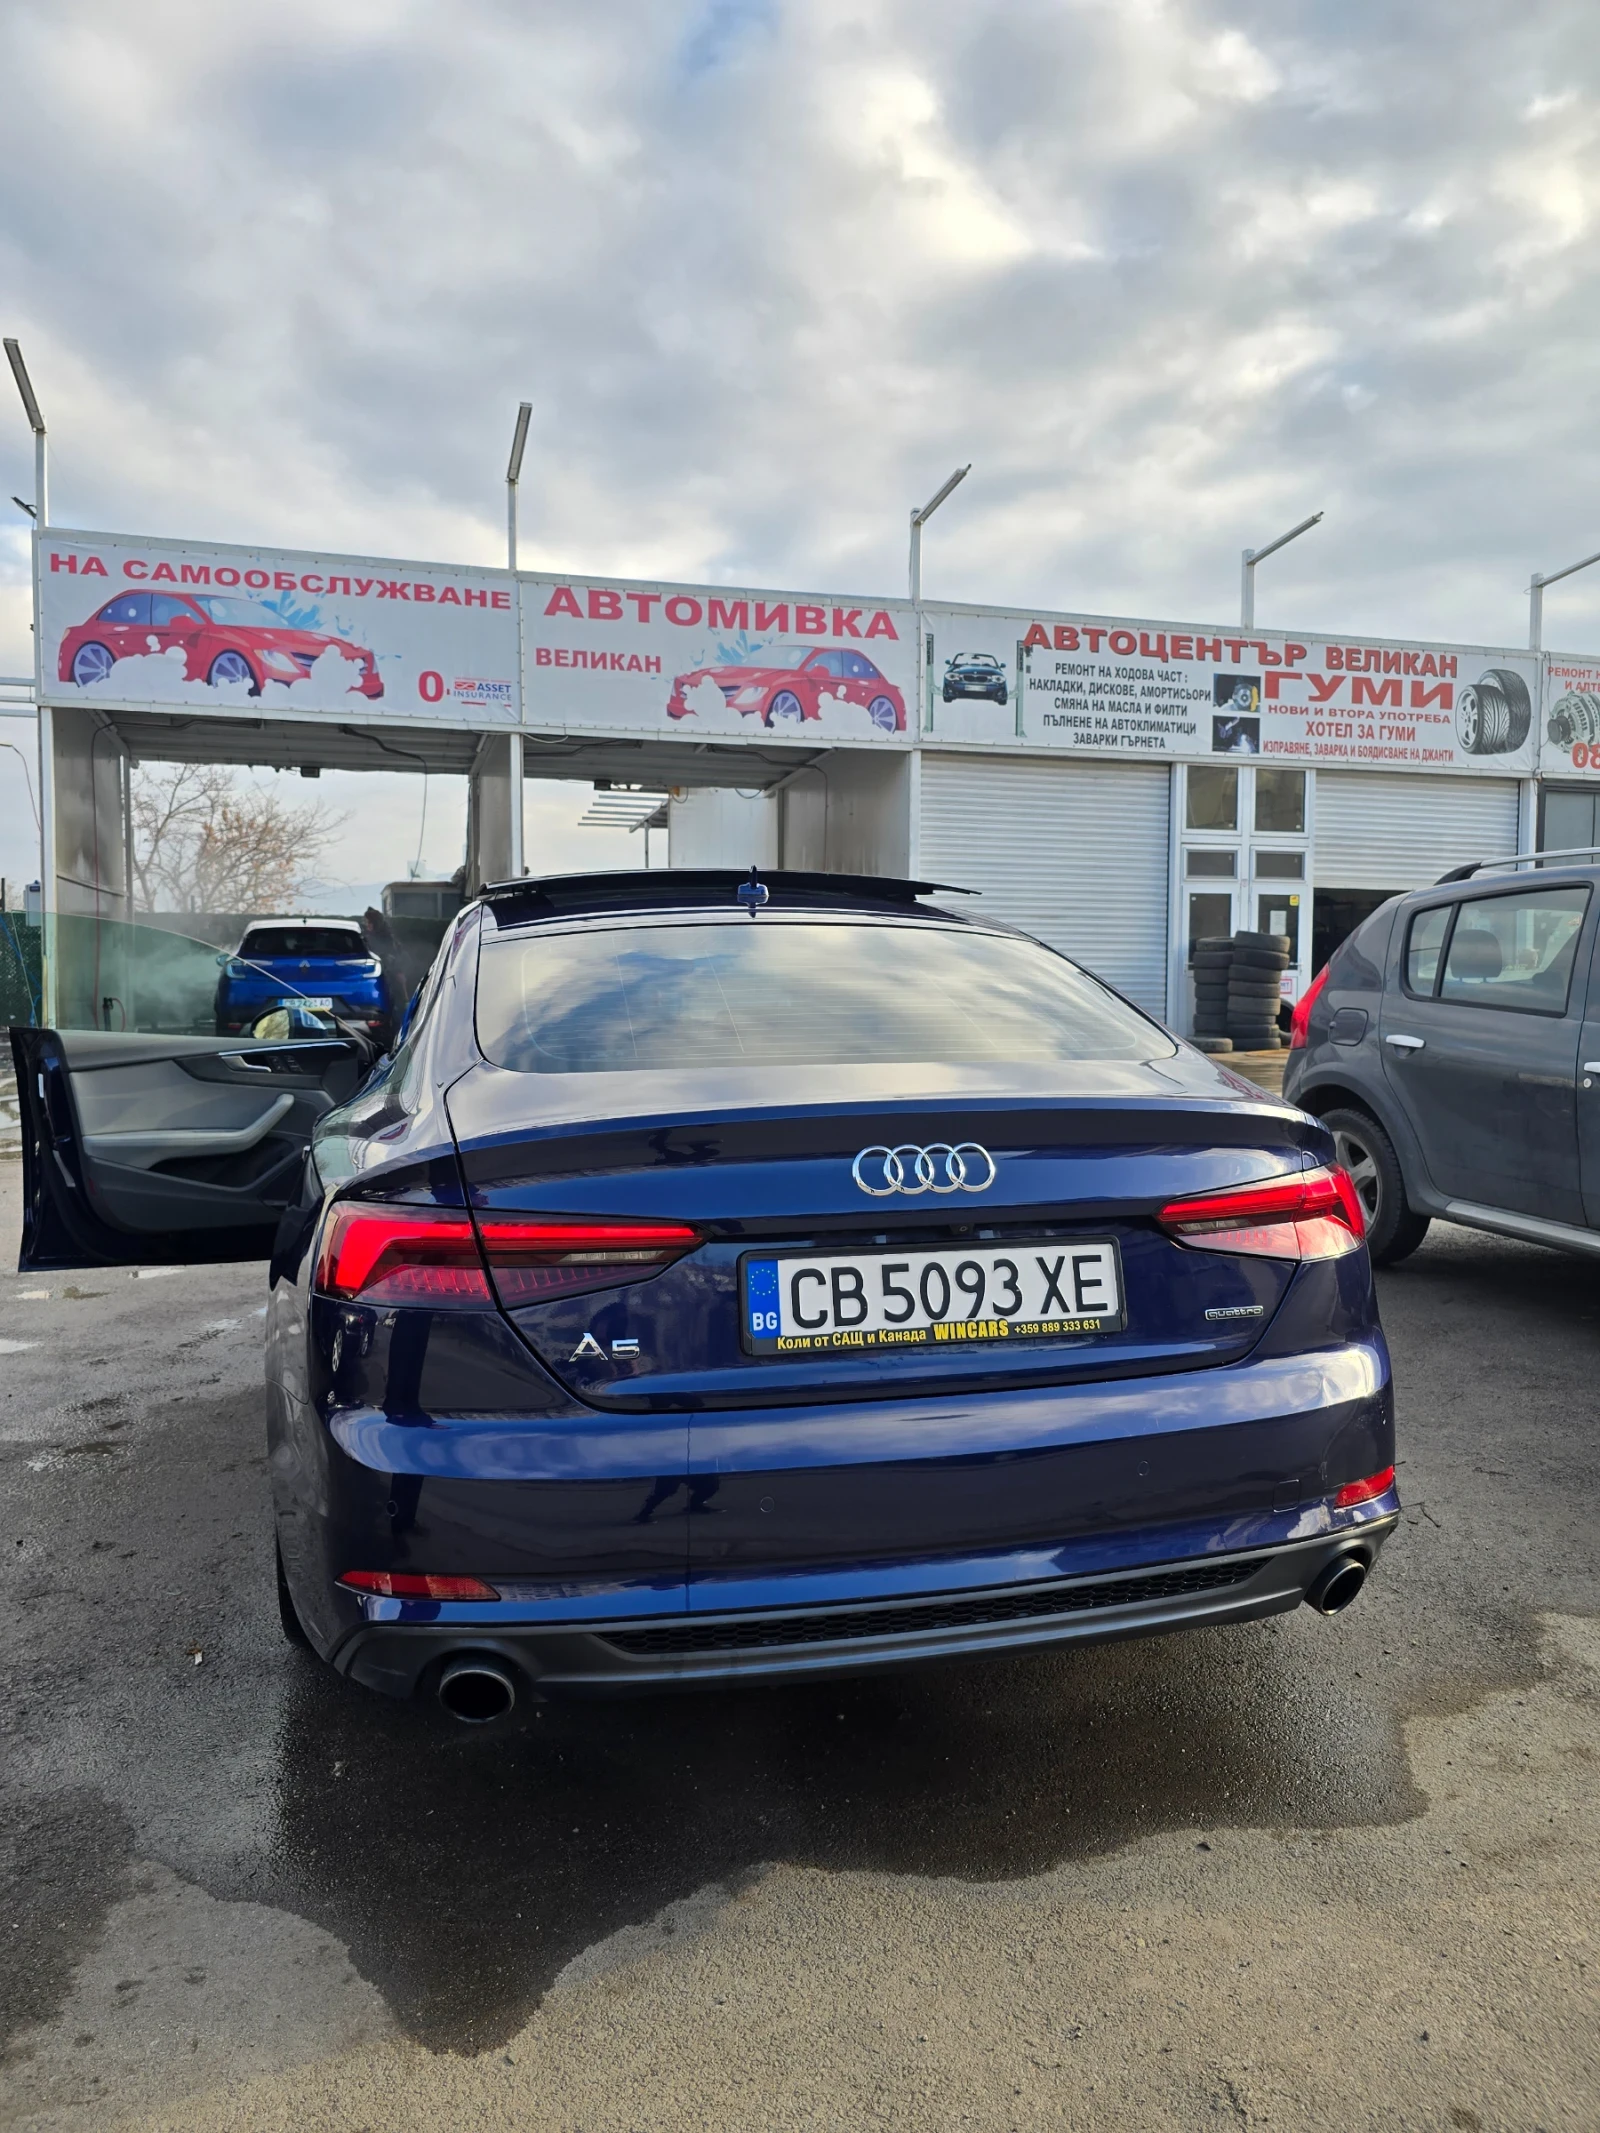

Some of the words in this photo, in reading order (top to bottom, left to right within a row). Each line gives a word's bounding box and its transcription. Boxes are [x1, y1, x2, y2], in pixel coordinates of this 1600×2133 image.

[50, 553, 108, 577] НА
[122, 559, 511, 610] САМООБСЛУЖВАНЕ
[544, 587, 899, 640] АВТОМИВКА
[536, 648, 661, 673] ВЕЛИКАН
[1024, 623, 1307, 667] АВТОЦЕНТЪР
[1326, 646, 1458, 678] ВЕЛИКАН
[1055, 663, 1095, 676] РЕМОНТ
[1098, 665, 1112, 678] НА
[1115, 666, 1154, 680] ХОДОВА
[1158, 669, 1182, 682] ЧАСТ
[1548, 667, 1592, 679] РЕМОНТ
[453, 690, 512, 701] INSURANCE
[477, 683, 511, 693] ASSET
[1029, 678, 1086, 696] НАКЛАДКИ,
[1089, 682, 1137, 698] ДИСКОВЕ,
[1141, 685, 1211, 701] АМОРТИСЬОРИ
[1264, 671, 1453, 710] ГУМИ
[1565, 681, 1572, 690] И
[1055, 697, 1089, 710] СМЯНА
[1092, 700, 1104, 711] НА
[1108, 700, 1142, 714] МАСЛА
[1145, 703, 1151, 714] И
[1154, 703, 1187, 716] ФИЛТИ
[1268, 704, 1309, 716] НОВИ
[1315, 707, 1323, 717] И
[1329, 708, 1374, 720] ВТОРА
[1379, 711, 1451, 724] УПОТРЕБА
[1044, 715, 1091, 728] ПЪЛНЕНЕ
[1095, 717, 1108, 729] НА
[1111, 718, 1196, 735] АВТОКЛИМАТИЦИ
[1306, 721, 1352, 738] ХОТЕЛ
[1358, 724, 1375, 739] ЗА
[1379, 725, 1416, 741] ГУМИ
[1073, 732, 1118, 746] ЗАВАРКИ
[1121, 735, 1165, 748] ГЪРНЕТА
[1263, 741, 1311, 756] ИЗПРАВЯНЕ,
[1314, 743, 1348, 757] ЗАВАРКА
[1351, 746, 1355, 758] И
[1358, 745, 1407, 760] БОЯДИСВАНЕ
[1410, 748, 1420, 761] НА
[1422, 748, 1453, 762] ДЖАНТИ
[882, 1258, 1022, 1322] 5093
[752, 1312, 777, 1332] BG
[1209, 1308, 1261, 1318] quattro
[777, 1336, 810, 1350] Коли
[814, 1336, 829, 1348] от
[833, 1331, 864, 1348] САЩ
[867, 1332, 875, 1344] и
[879, 1329, 926, 1343] Канада
[934, 1320, 1008, 1340] WINCARS
[1014, 1324, 1038, 1335] +359
[1042, 1322, 1059, 1334] 889
[1063, 1321, 1080, 1332] 333
[1084, 1319, 1101, 1331] 631
[569, 1332, 640, 1362] A5
